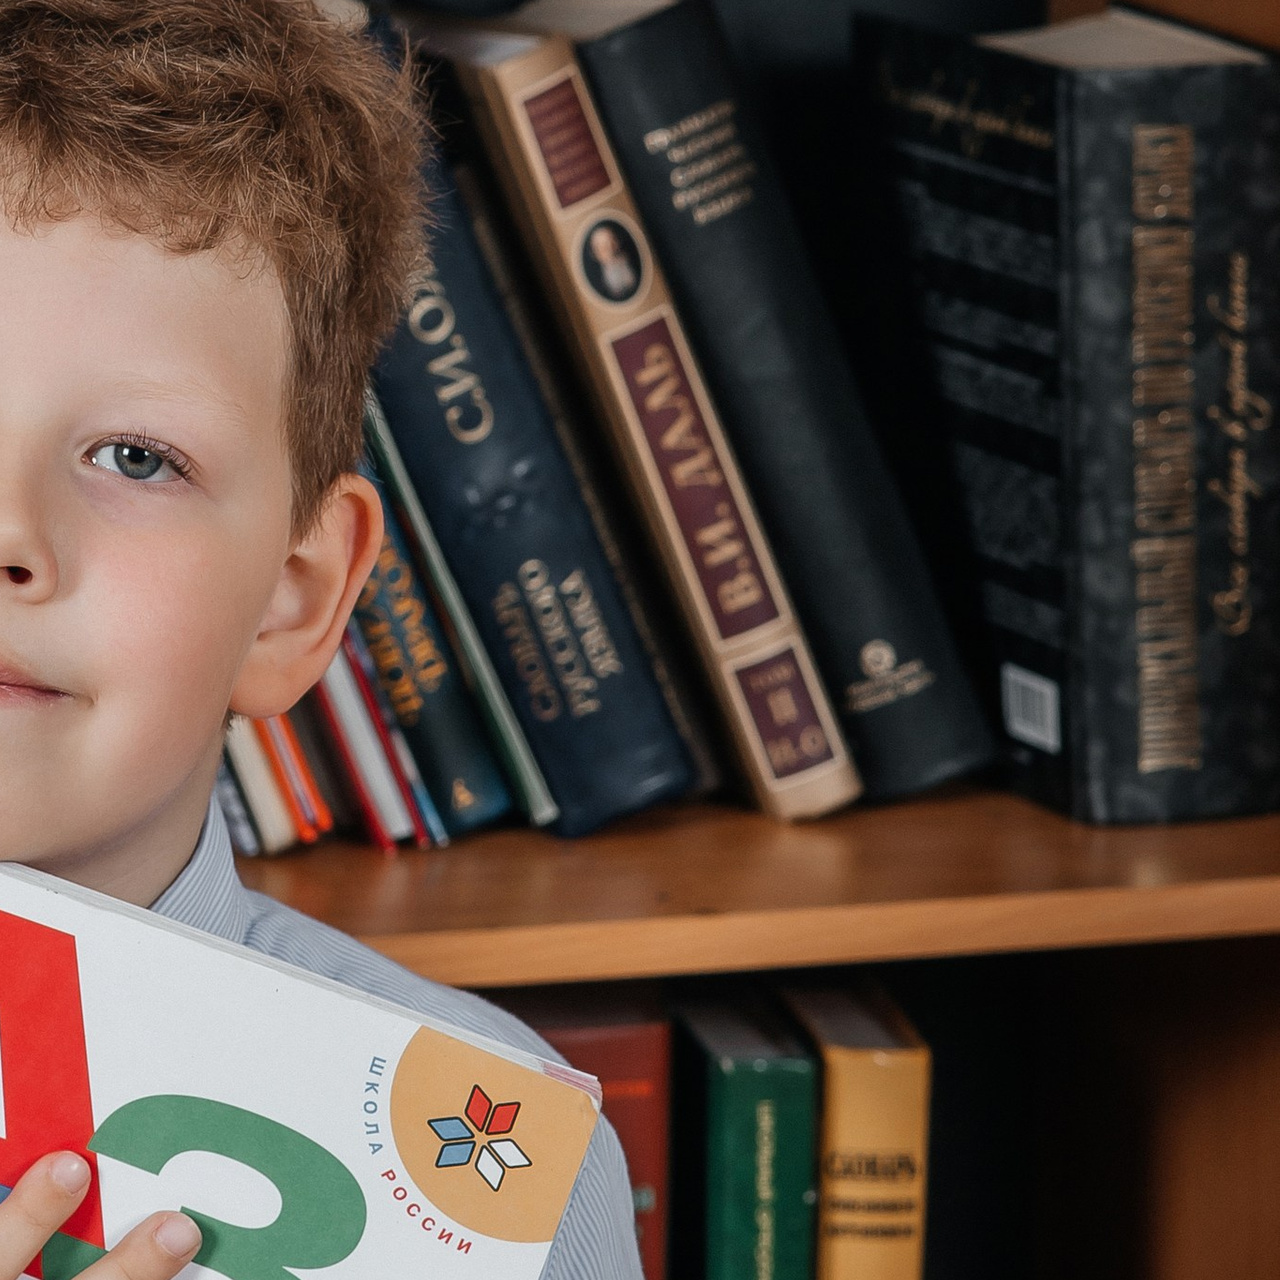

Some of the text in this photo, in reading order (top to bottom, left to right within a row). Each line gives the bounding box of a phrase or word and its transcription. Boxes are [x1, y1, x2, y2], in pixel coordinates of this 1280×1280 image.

[634, 342, 723, 491] ДАЛЬ
[363, 1056, 473, 1255] ШКОЛА РОССИИ
